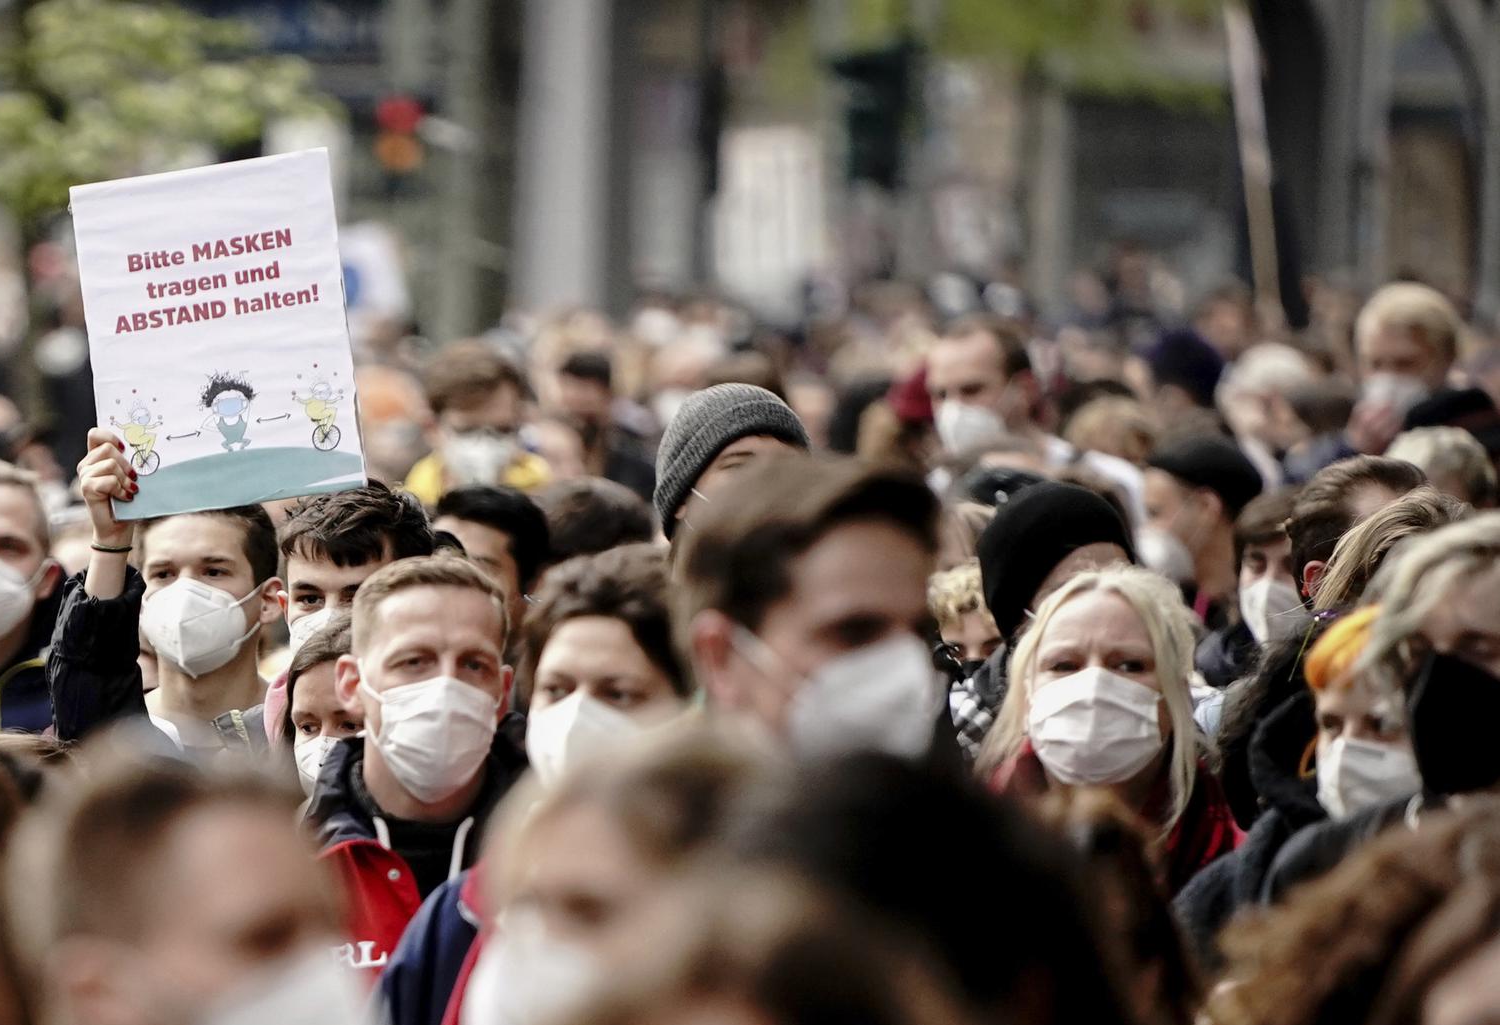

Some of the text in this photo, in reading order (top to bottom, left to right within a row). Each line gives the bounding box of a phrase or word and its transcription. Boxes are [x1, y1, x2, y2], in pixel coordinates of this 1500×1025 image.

[127, 228, 293, 272] Bitte MASKEN
[146, 260, 281, 299] tragen und
[115, 283, 320, 334] ABSTAND halten!
